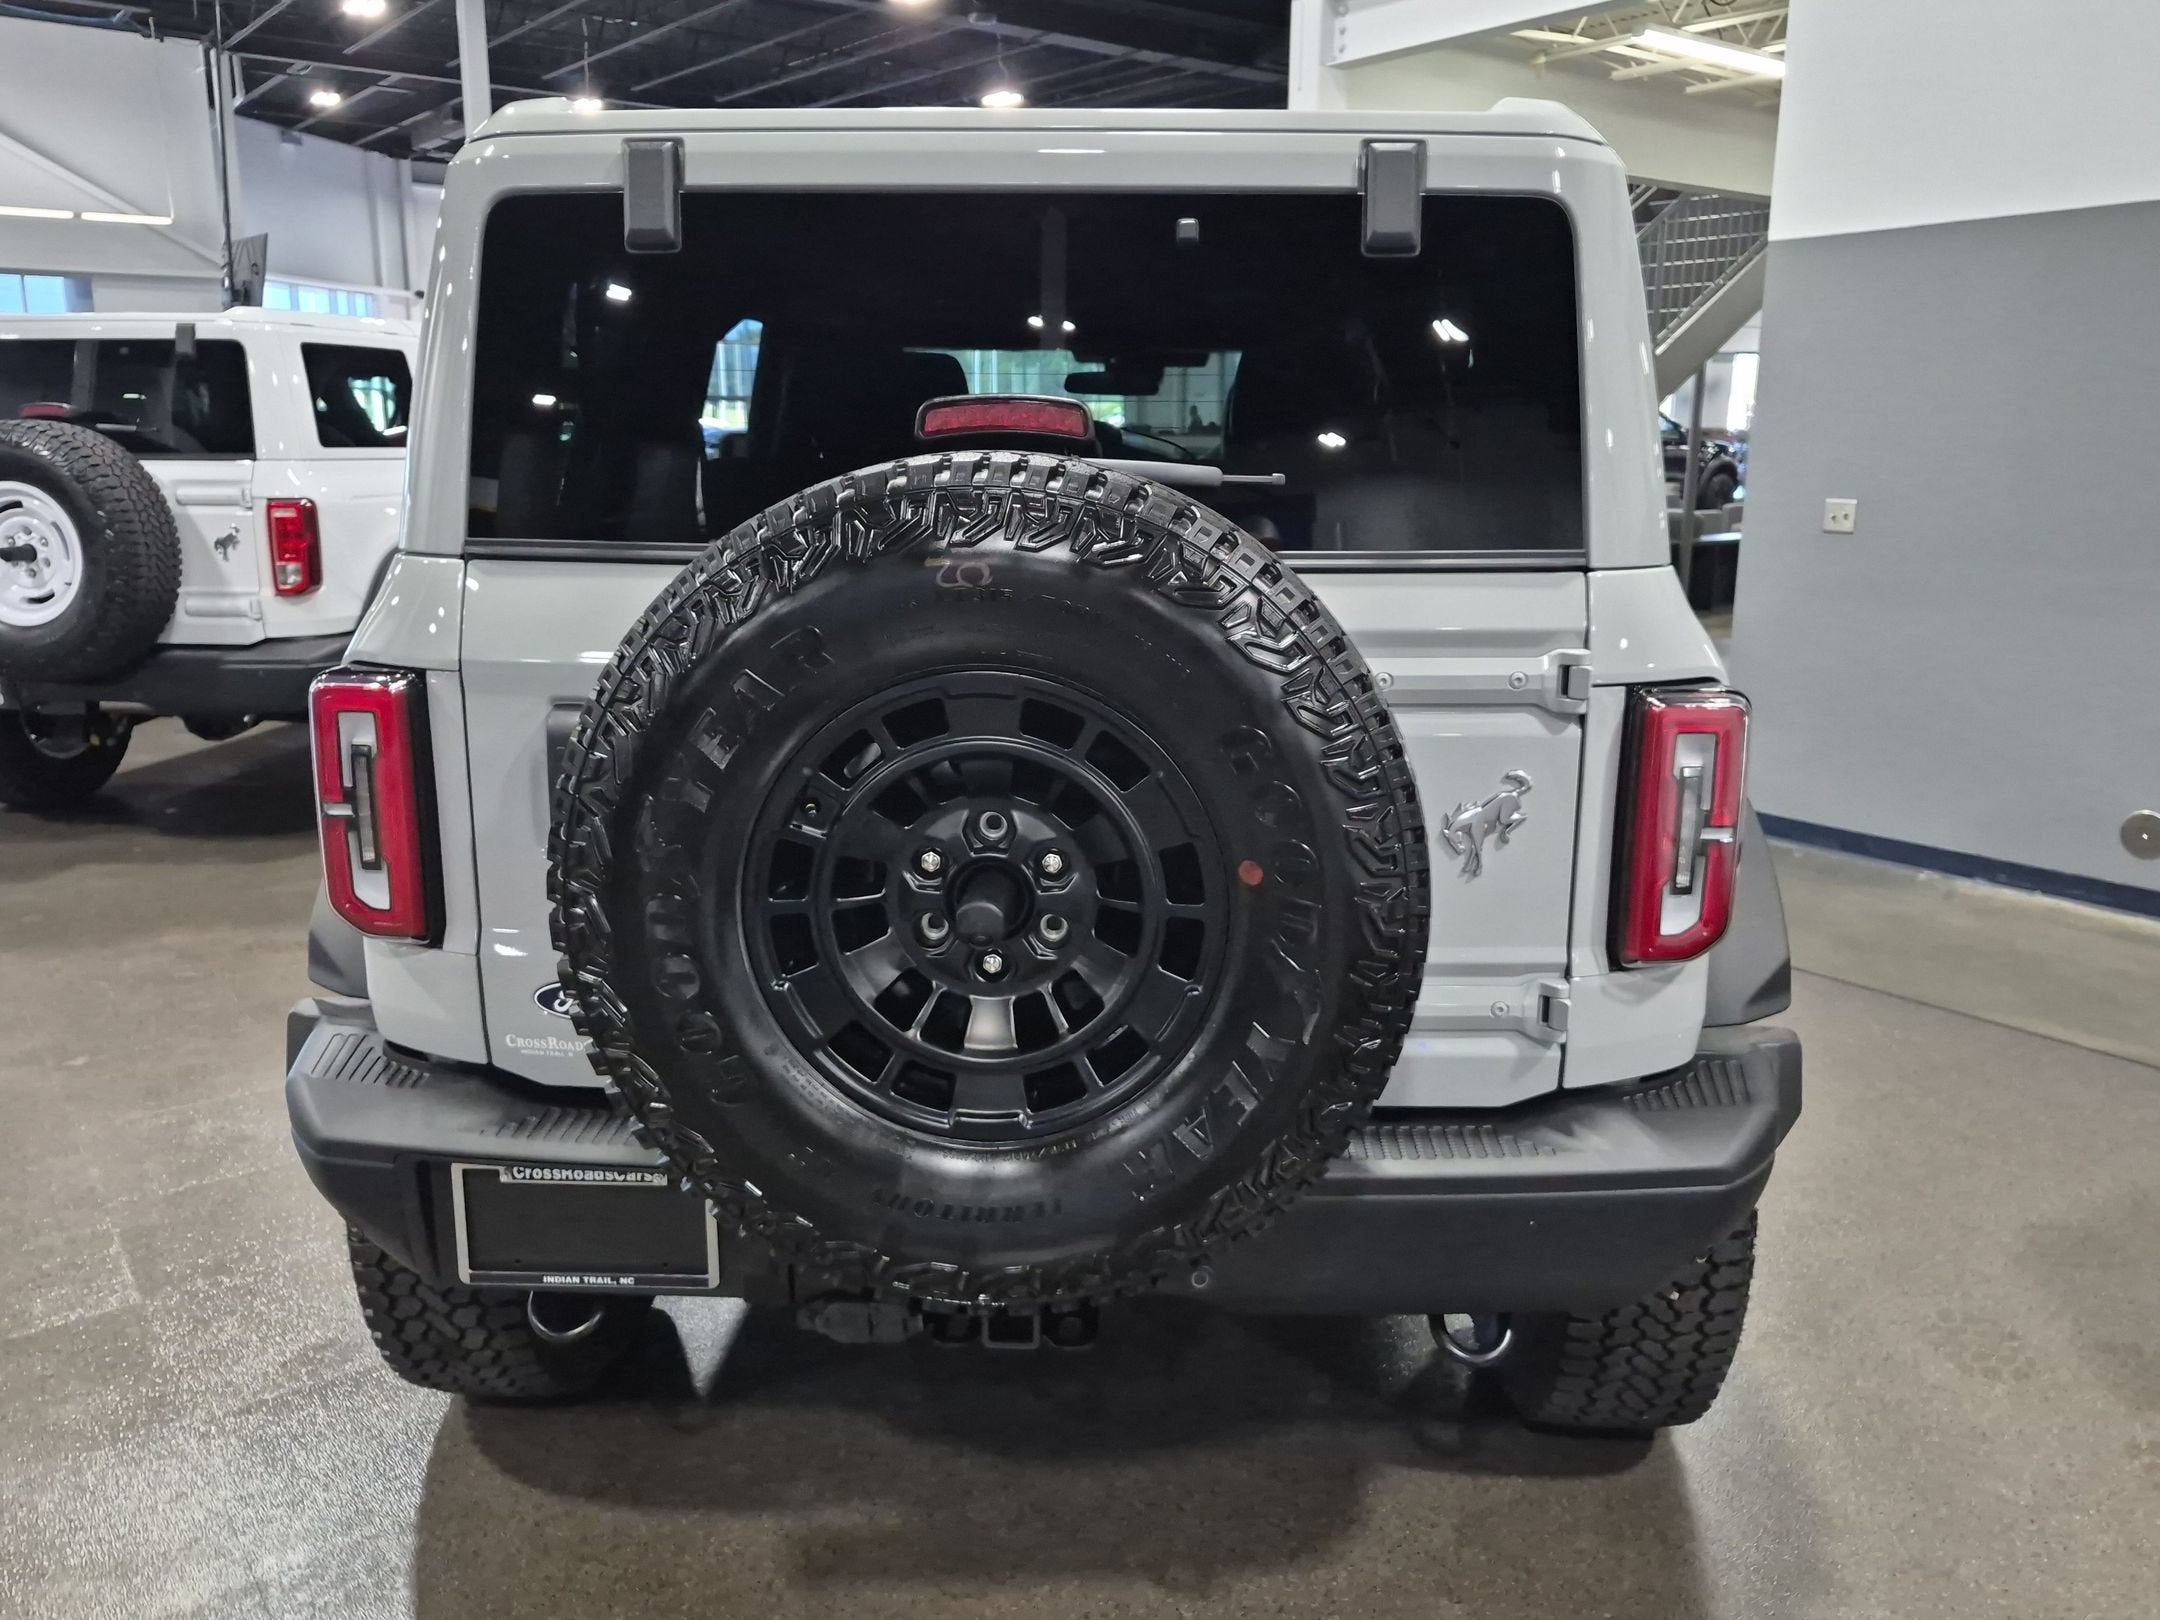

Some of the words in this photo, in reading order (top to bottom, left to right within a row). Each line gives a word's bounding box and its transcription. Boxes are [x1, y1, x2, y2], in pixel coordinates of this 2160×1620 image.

[1121, 723, 1324, 1202] GOODYEAR
[543, 1275, 580, 1284] INDIAN
[582, 1276, 617, 1286] TRAIL,
[620, 1277, 635, 1285] NC
